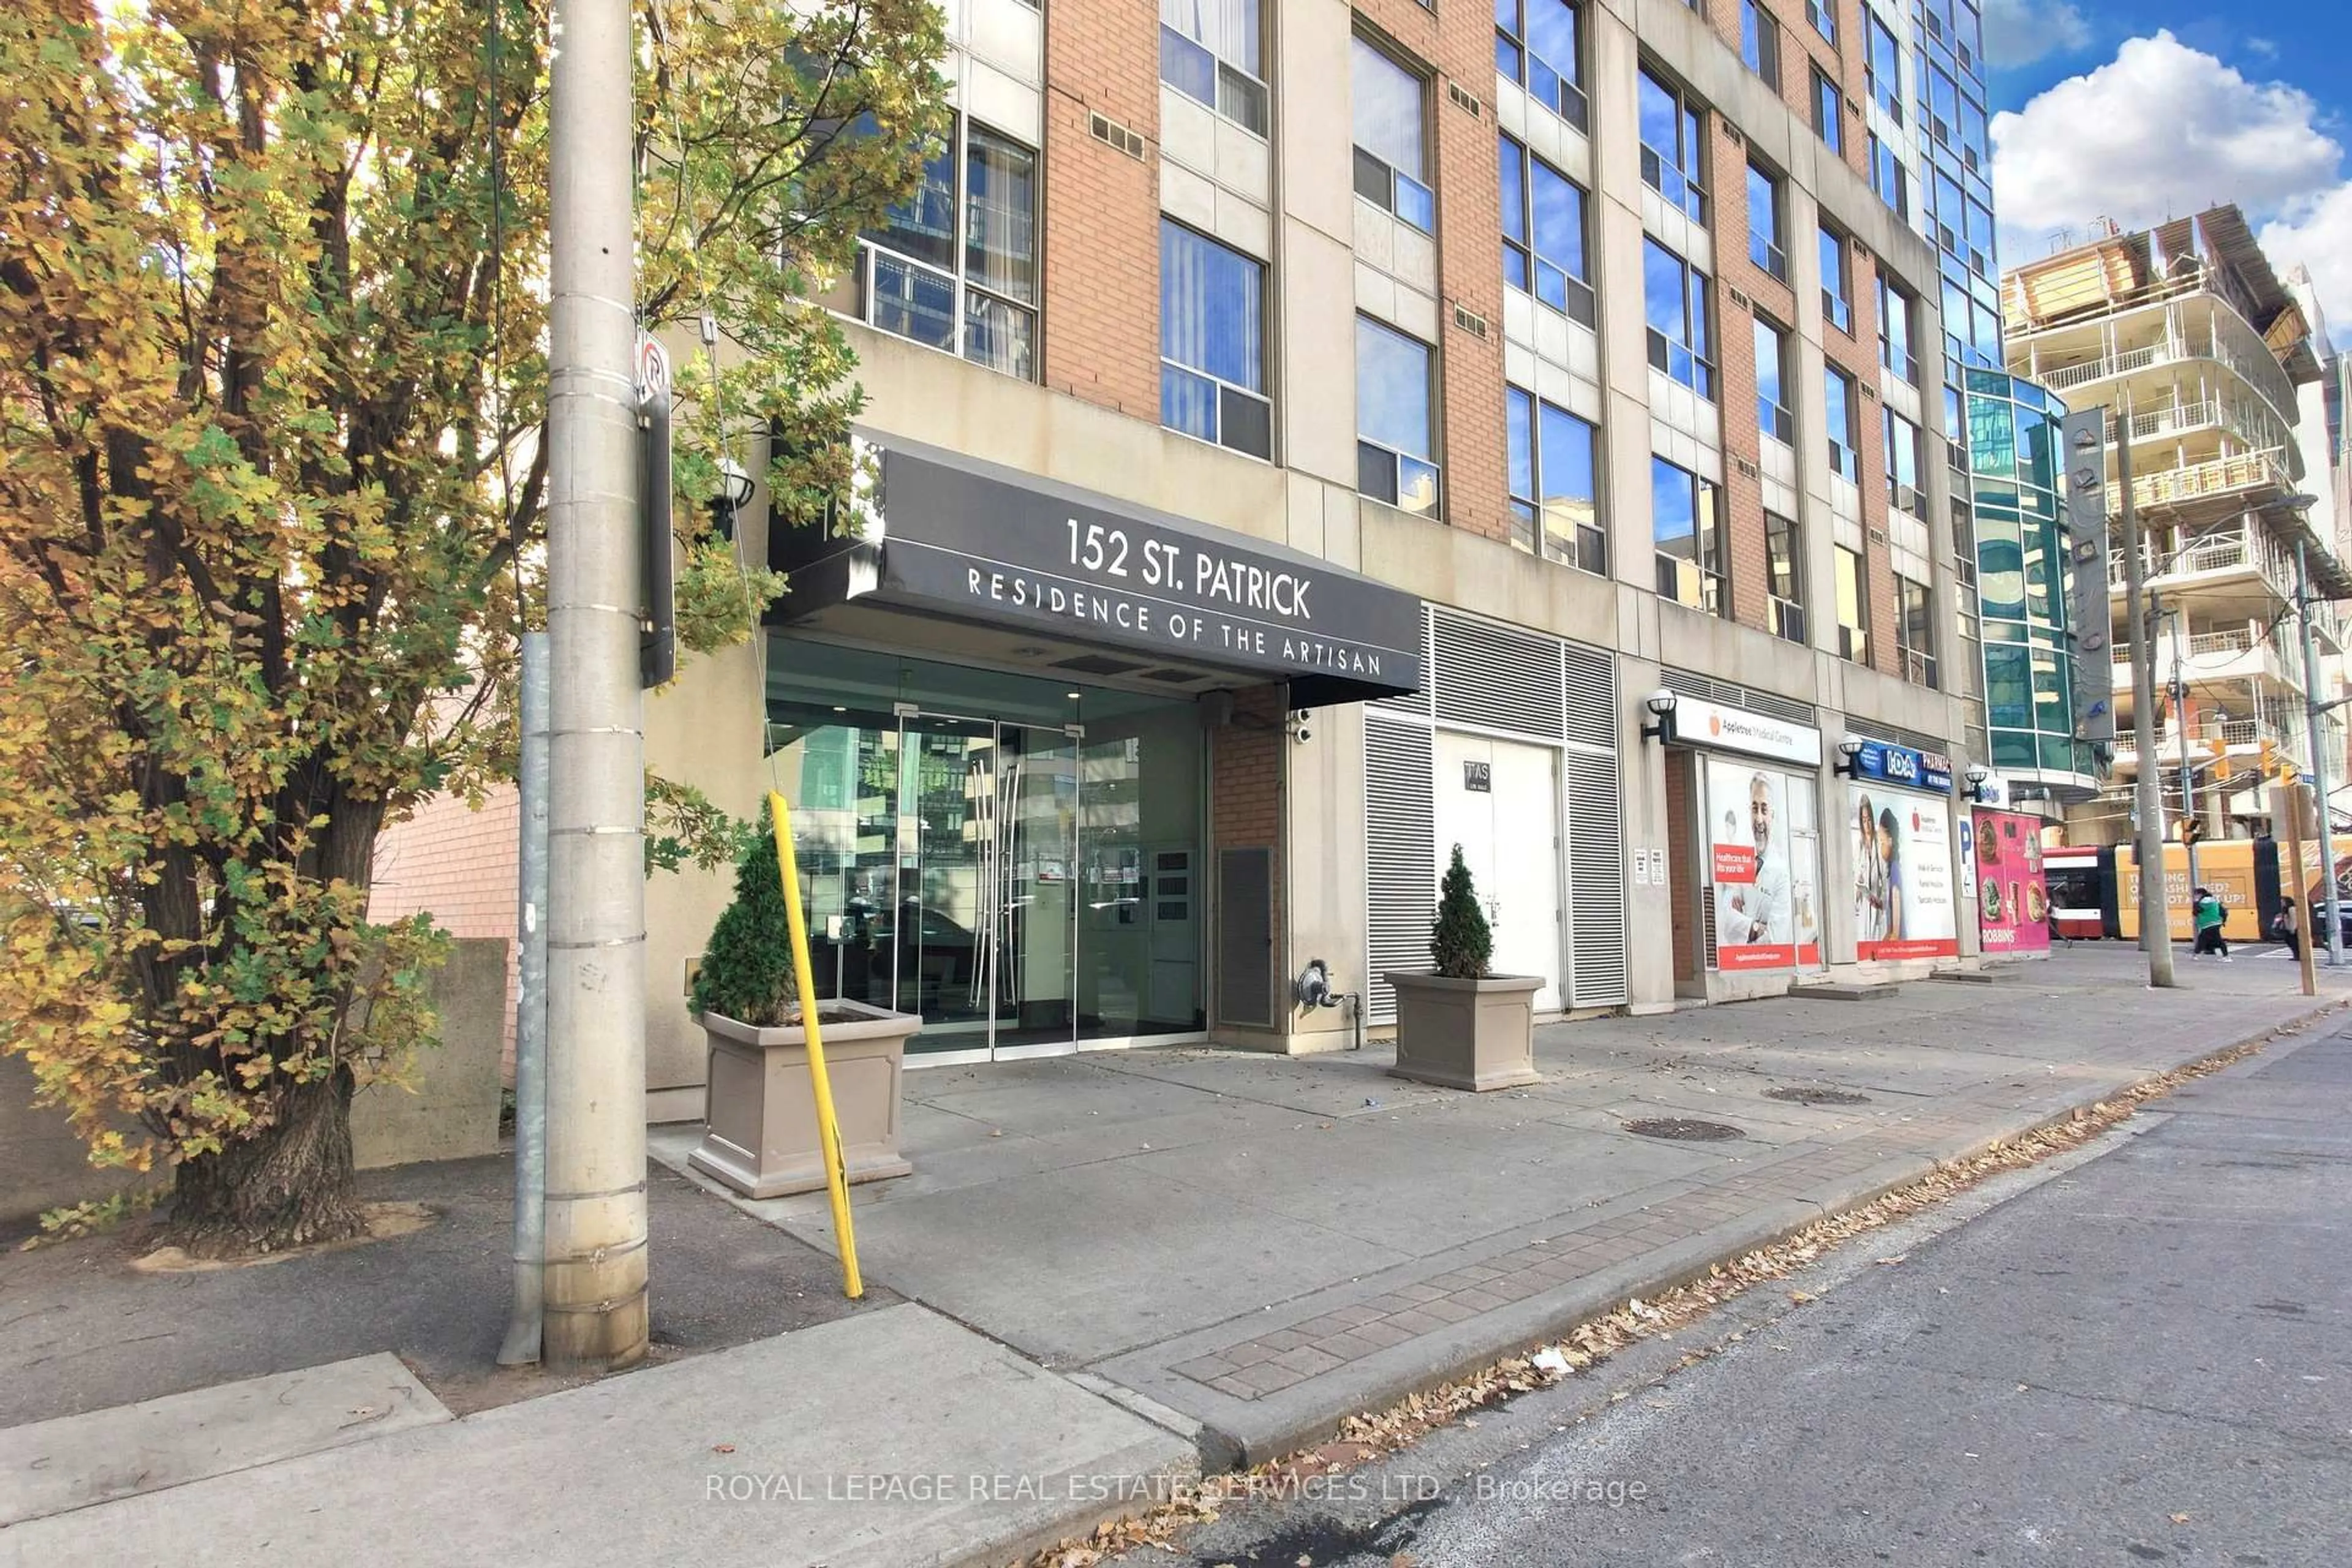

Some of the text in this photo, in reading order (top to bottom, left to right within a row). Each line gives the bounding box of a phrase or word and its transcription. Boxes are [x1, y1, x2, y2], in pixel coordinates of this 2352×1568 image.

[1066, 518, 1311, 620] 152 ST. PATRICK
[968, 567, 1381, 676] RESIDENCE OF THE ARTISAN
[1960, 820, 1972, 864] P
[1982, 929, 2015, 943] ROBBINS
